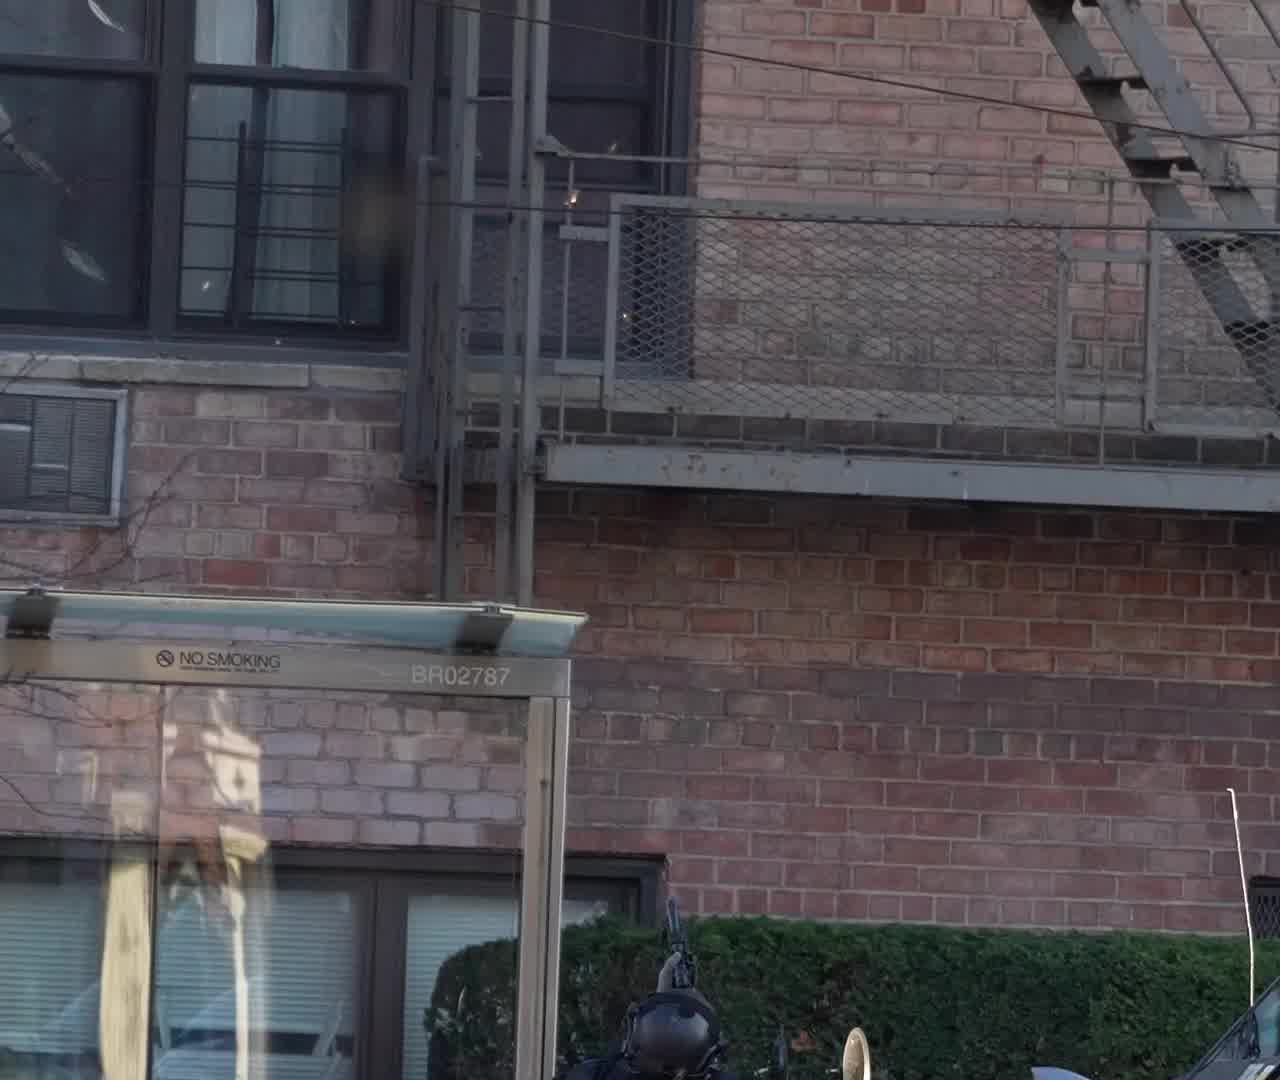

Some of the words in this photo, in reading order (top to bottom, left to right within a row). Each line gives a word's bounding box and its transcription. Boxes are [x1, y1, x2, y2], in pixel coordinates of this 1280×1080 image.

[180, 651, 204, 665] NO
[207, 652, 280, 669] SMOKING
[411, 664, 510, 686] BR02787
